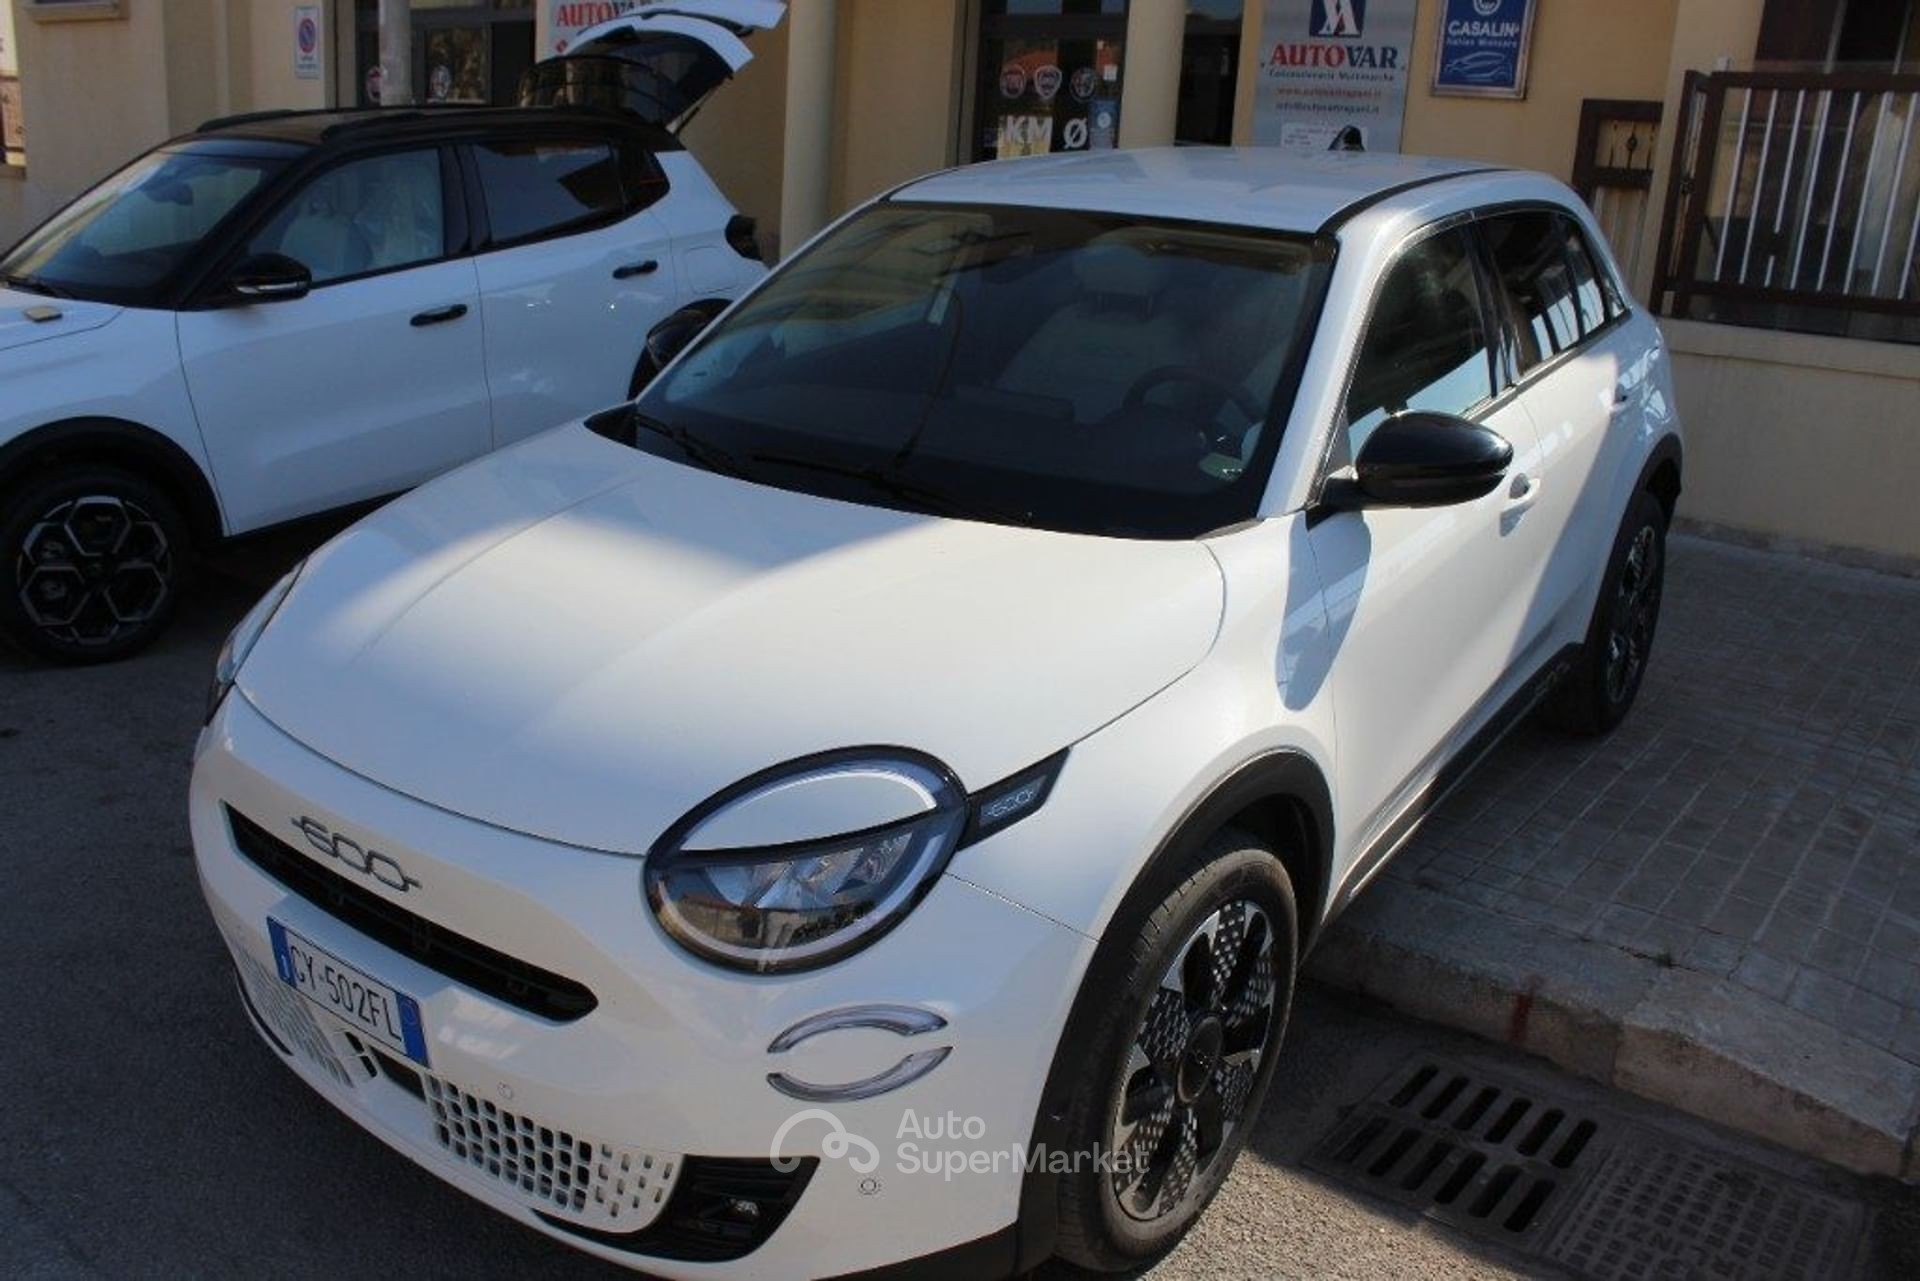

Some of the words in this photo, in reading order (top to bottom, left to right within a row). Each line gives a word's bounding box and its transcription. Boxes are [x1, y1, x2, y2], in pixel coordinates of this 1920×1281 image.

[556, 1, 650, 27] AUTOV
[1269, 42, 1399, 69] AUTOVAR
[1004, 115, 1054, 144] KM
[292, 815, 422, 892] 600
